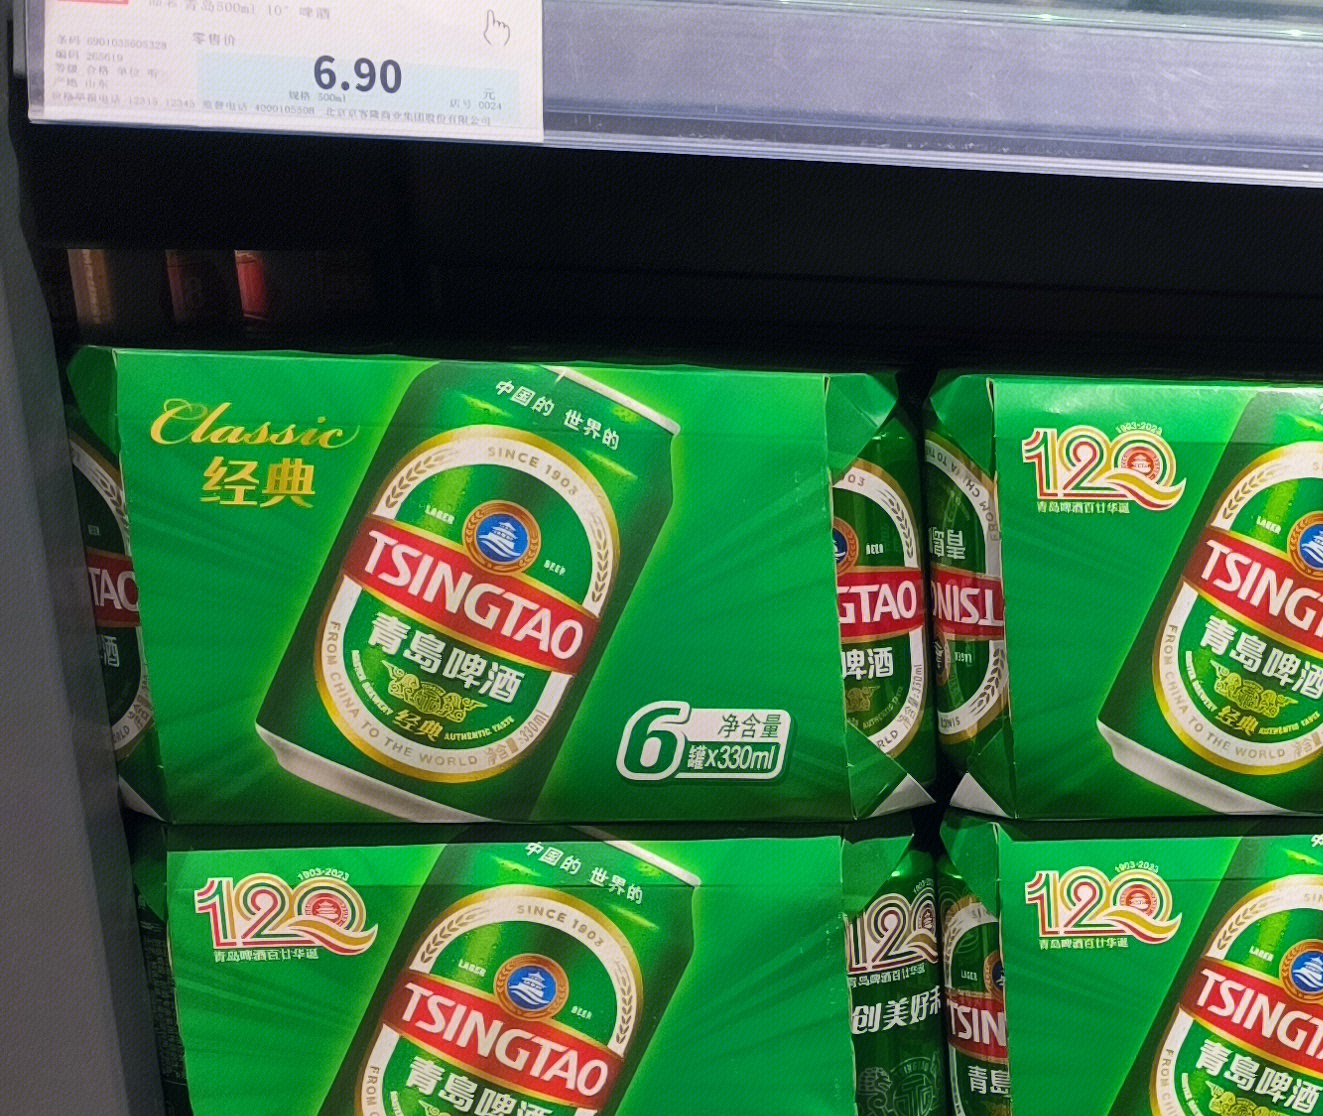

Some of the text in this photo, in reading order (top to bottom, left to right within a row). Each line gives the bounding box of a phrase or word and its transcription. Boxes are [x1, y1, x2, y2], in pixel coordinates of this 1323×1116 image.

[193, 32, 236, 46] 零售价
[314, 54, 401, 93] 6.90
[318, 92, 345, 102] 500ml
[479, 101, 501, 110] 0024
[150, 399, 359, 450] Classic
[495, 379, 620, 450] 中国的 世界的
[201, 456, 315, 509] 经典
[487, 445, 580, 497] SINCE 1903
[367, 530, 584, 662] TSINGTAO
[370, 611, 526, 705] 青島啤酒
[618, 701, 688, 780] 6
[717, 713, 782, 739] 净含量
[418, 752, 479, 767] WORLD
[401, 982, 608, 1095] TSINGTAO
